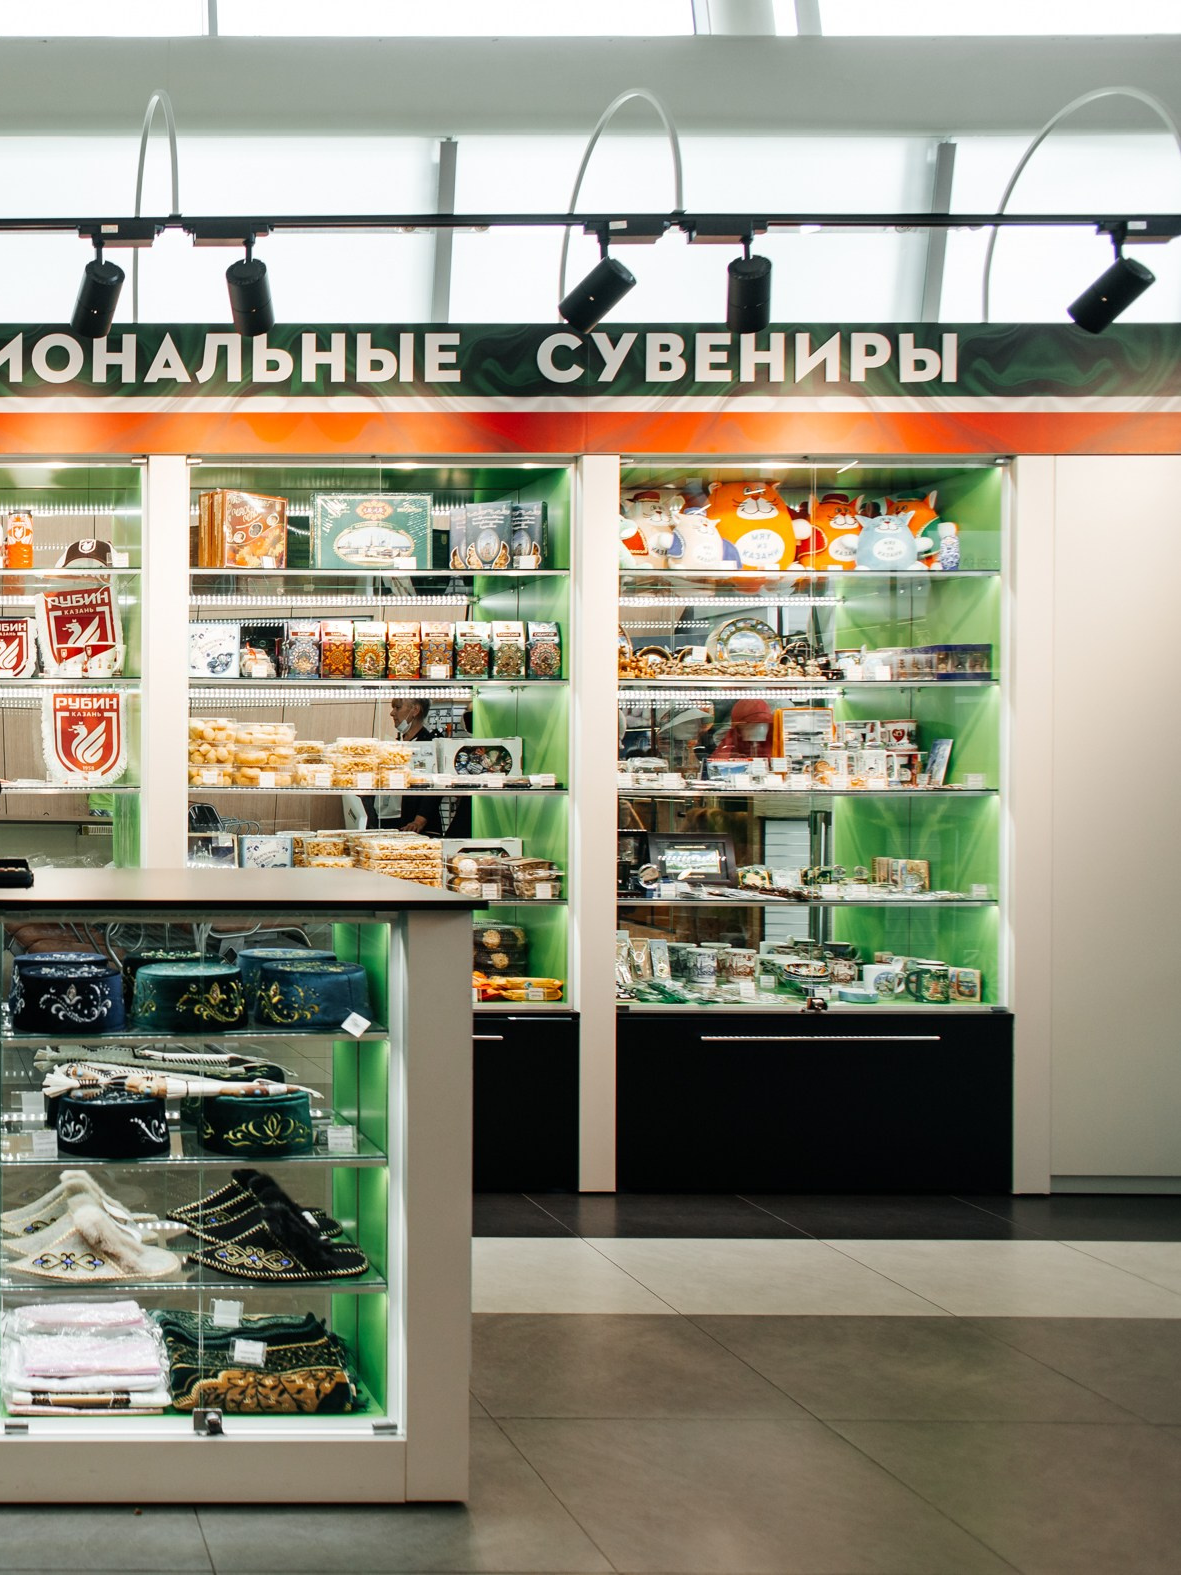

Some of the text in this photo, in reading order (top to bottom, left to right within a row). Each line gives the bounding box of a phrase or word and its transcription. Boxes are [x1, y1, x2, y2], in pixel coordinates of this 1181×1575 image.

[537, 332, 957, 383] СУВЕНИРЫ
[742, 548, 779, 560] КАЗАНИ
[48, 591, 109, 608] РУБИН
[55, 697, 117, 709] РУБИН
